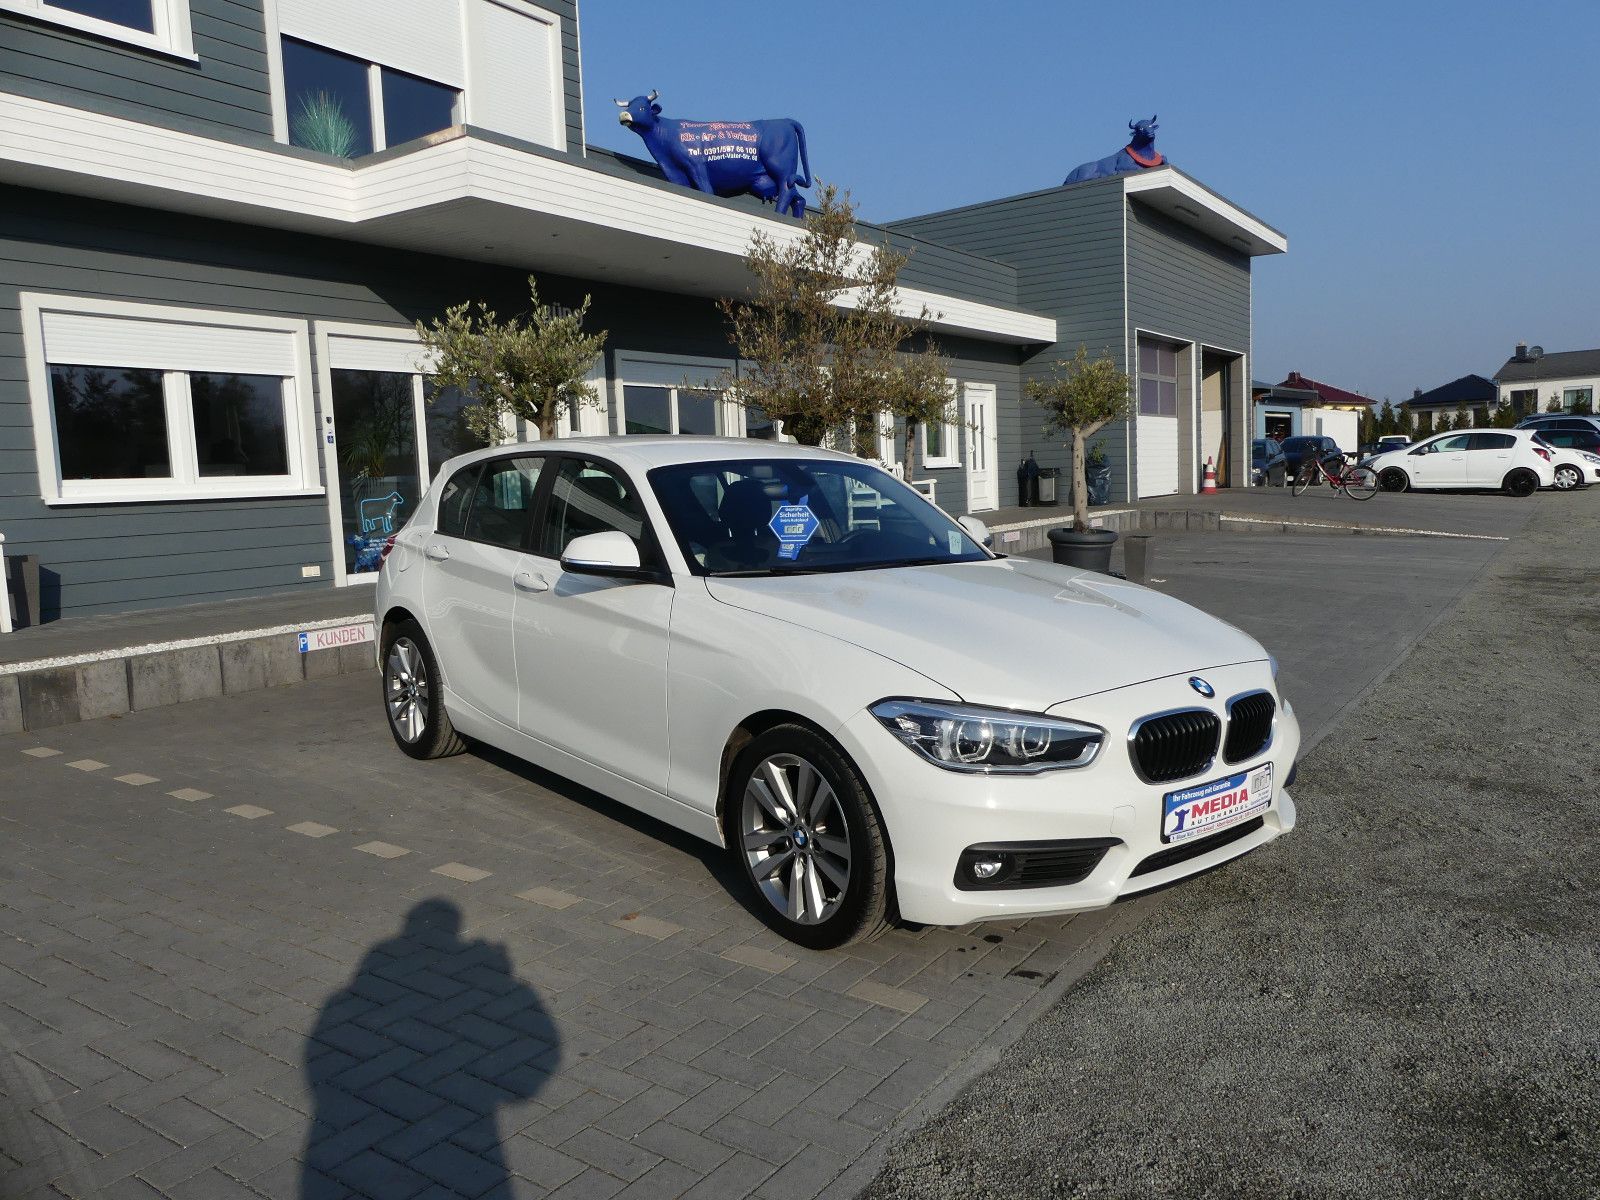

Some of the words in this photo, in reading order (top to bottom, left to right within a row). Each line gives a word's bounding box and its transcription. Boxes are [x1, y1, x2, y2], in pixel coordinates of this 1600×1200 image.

[300, 637, 308, 649] P
[316, 626, 366, 648] KUNDEN
[1190, 803, 1248, 826] AUTOHANDEL
[1191, 788, 1249, 819] MEDIA
